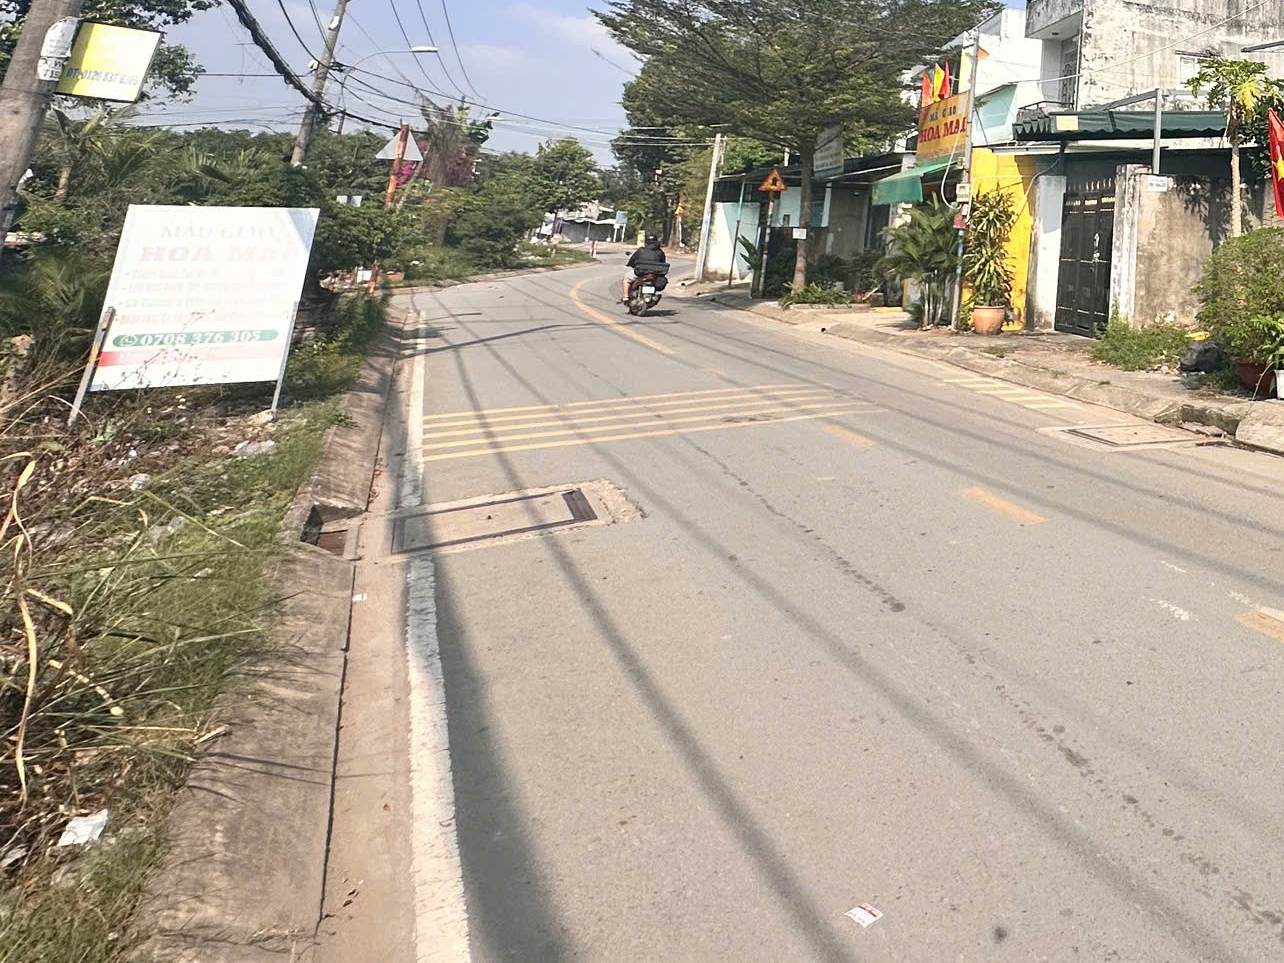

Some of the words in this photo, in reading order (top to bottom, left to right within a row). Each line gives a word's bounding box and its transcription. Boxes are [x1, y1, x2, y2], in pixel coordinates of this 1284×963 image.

[919, 126, 940, 143] HOA
[943, 117, 967, 137] MAI
[140, 332, 184, 347] 0708
[191, 330, 225, 344] 376
[232, 329, 262, 342] 305
